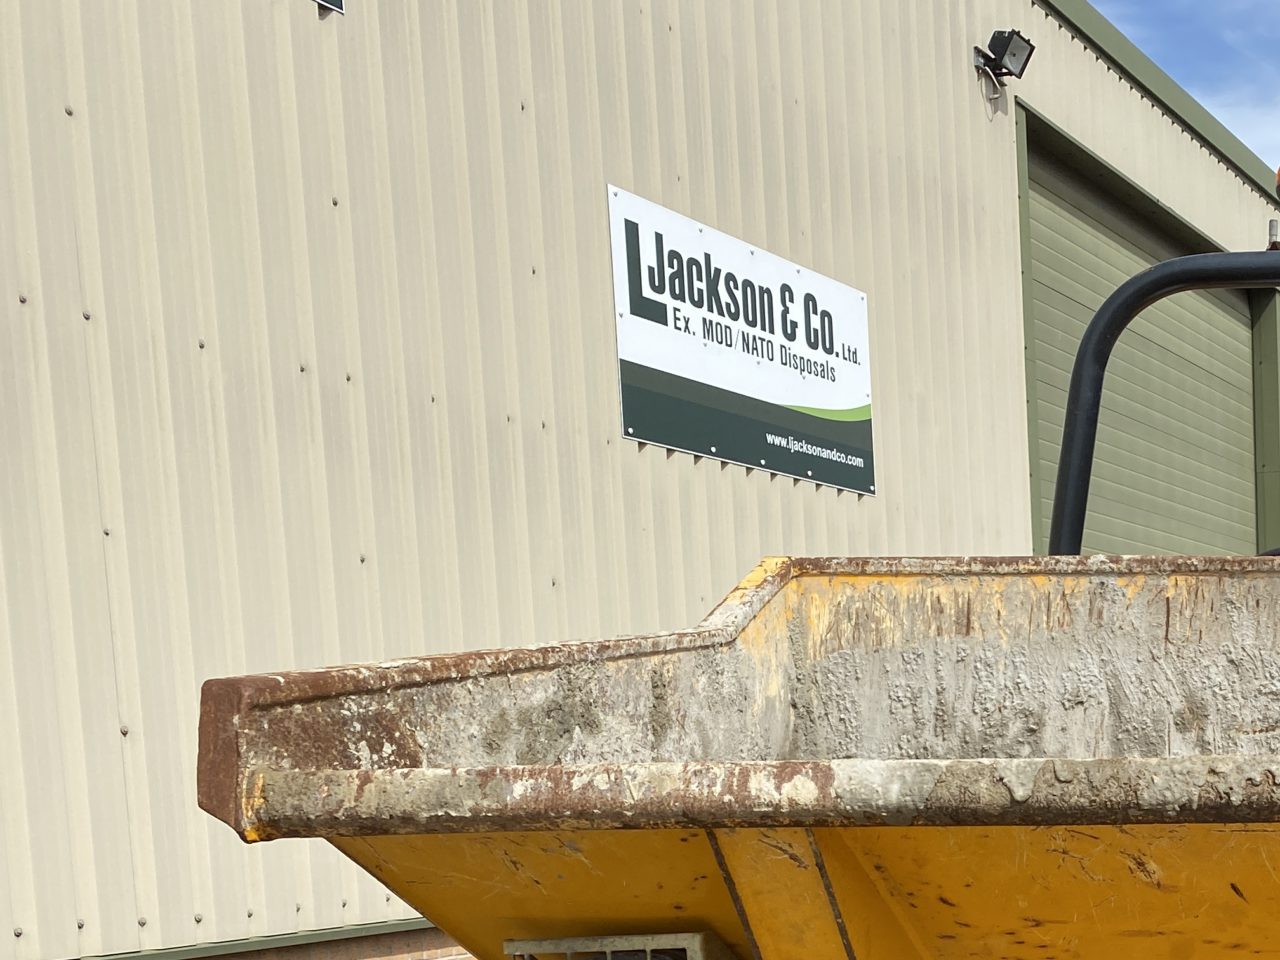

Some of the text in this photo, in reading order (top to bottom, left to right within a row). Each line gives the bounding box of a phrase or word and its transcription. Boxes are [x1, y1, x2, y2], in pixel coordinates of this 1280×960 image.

[673, 307, 696, 336] Ex.
[780, 344, 836, 383] Disposals
[780, 283, 798, 342] &
[803, 293, 839, 358] Co.
[842, 343, 861, 366] Ltd.
[765, 433, 864, 468] www.ljacksonandco.com
